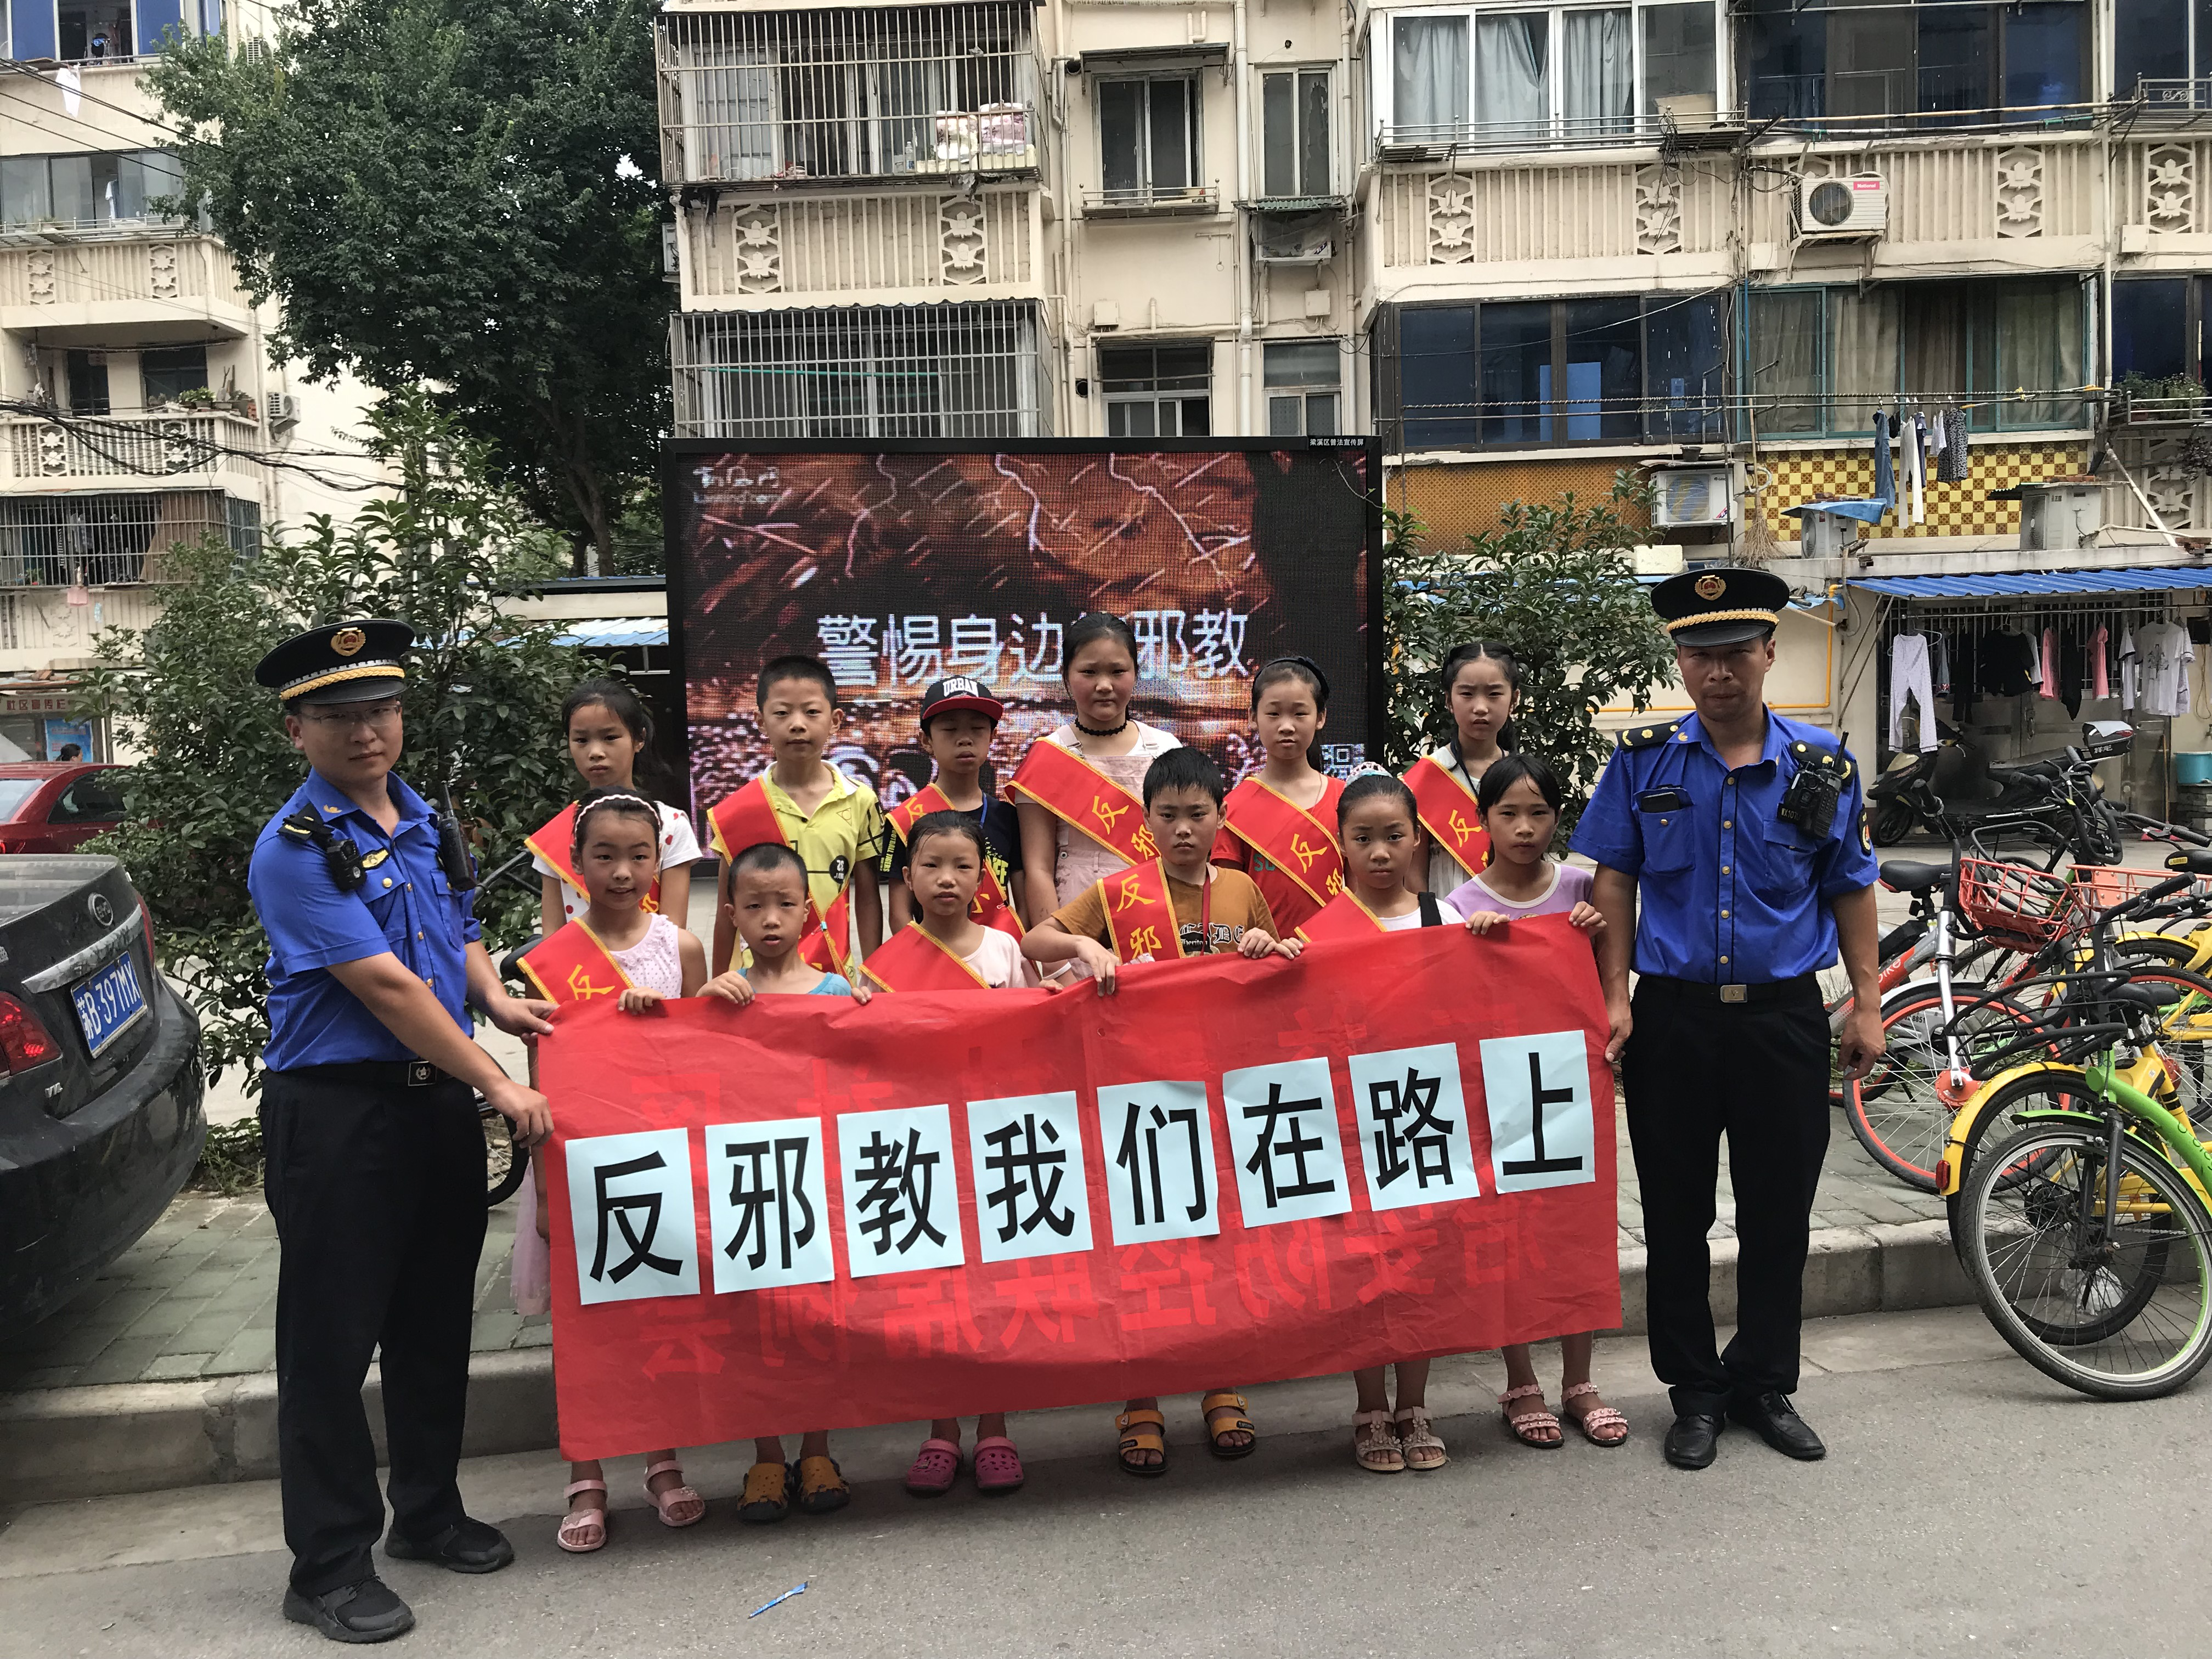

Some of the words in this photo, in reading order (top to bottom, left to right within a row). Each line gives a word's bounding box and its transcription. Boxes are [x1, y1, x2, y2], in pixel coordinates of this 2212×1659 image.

[817, 607, 1249, 686] 警惕身边邪教
[943, 678, 979, 697] URBAN
[887, 828, 897, 853] OOTBALL
[589, 1051, 1583, 1284] 反邪教我们在路上
